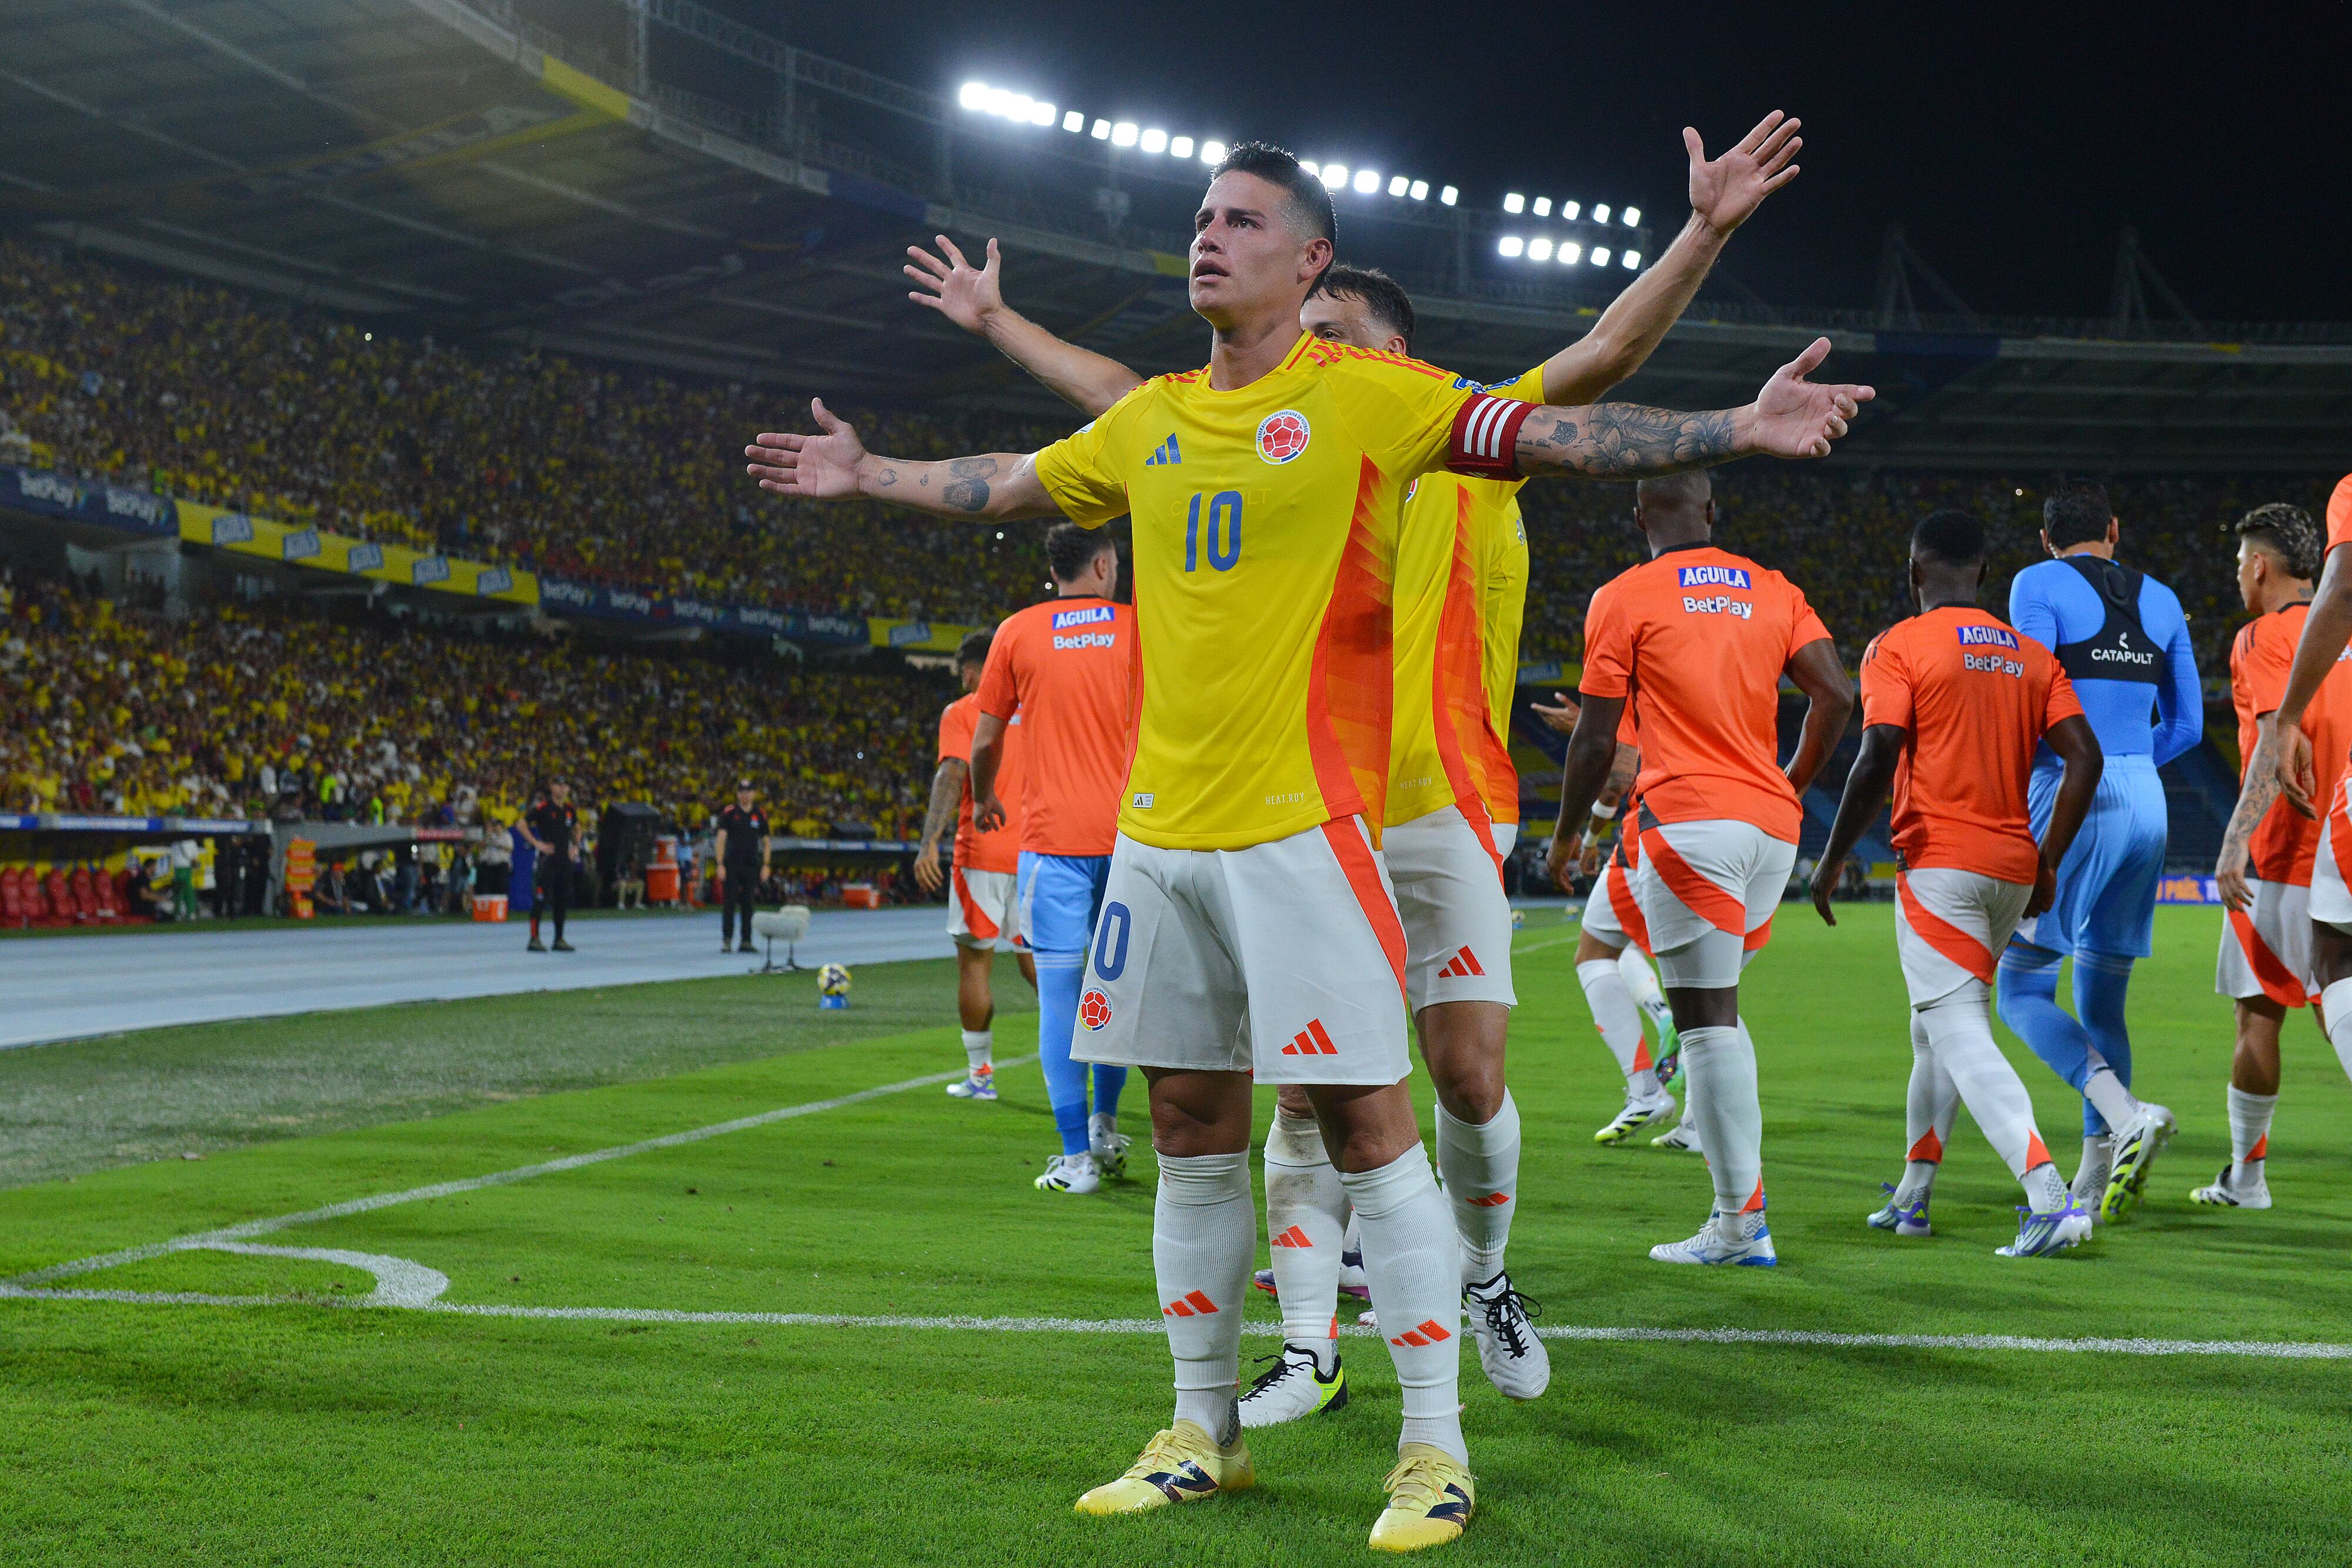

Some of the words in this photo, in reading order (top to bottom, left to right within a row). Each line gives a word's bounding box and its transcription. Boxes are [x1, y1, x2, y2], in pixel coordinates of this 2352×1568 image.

[1185, 490, 1243, 572] 10
[1683, 566, 1748, 588] AGUILA
[1055, 607, 1112, 628] AGUILA
[1682, 595, 1753, 620] BetPlay
[1053, 632, 1115, 650] BetPlay
[1963, 626, 2016, 648] AGUILA
[1963, 653, 2024, 678] BetPlay
[2092, 648, 2154, 665] CATAPULT
[1265, 793, 1305, 805] HEAT.RDY
